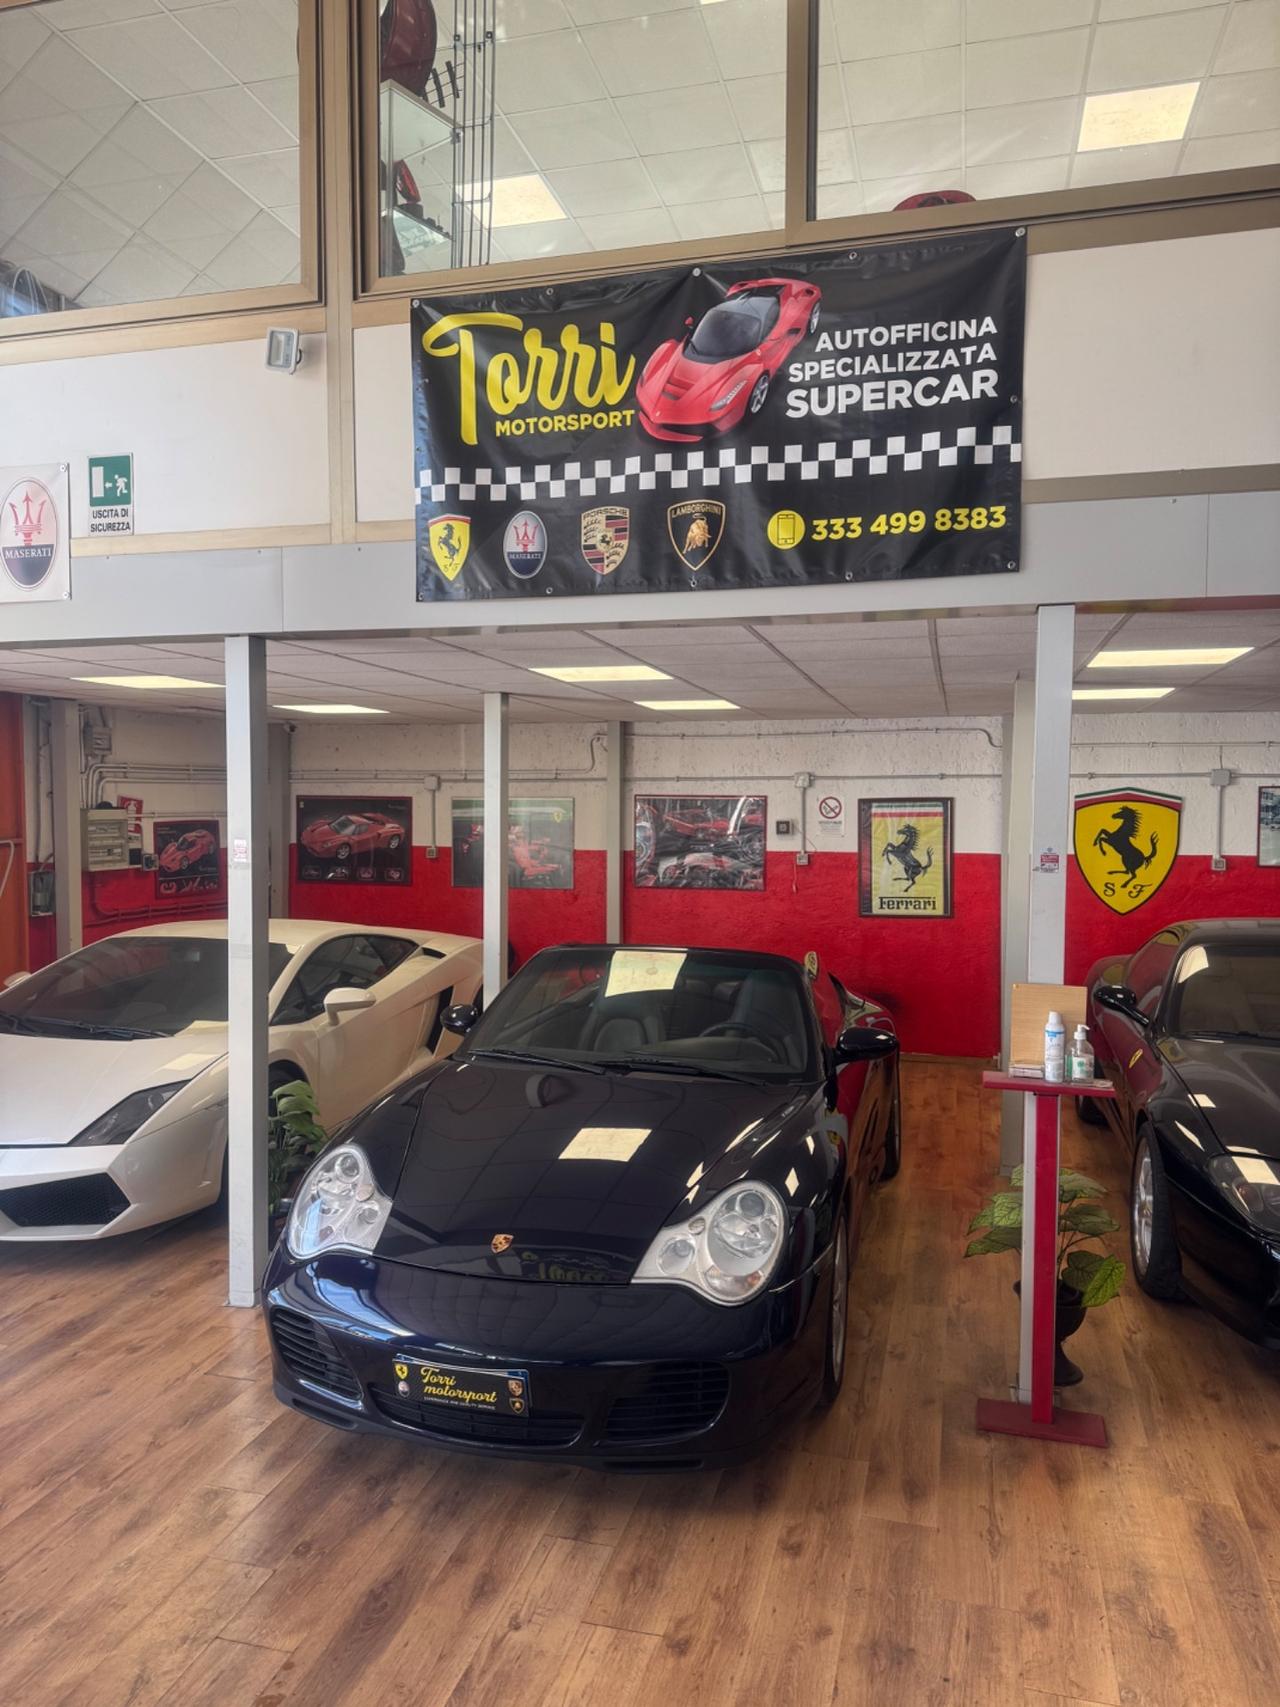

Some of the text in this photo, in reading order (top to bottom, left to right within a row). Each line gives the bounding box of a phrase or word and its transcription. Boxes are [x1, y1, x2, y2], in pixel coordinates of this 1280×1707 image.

[815, 316, 998, 352] AUTOFFICINA
[788, 343, 997, 383] SPECIALIZZATA
[422, 312, 636, 445] Torri
[785, 369, 999, 419] SUPERCAR
[495, 409, 636, 437] MOTORSPORT
[92, 508, 129, 519] USCITA DI
[672, 503, 721, 518] LAMBORGHINI
[90, 521, 131, 533] SICUREZZA
[811, 505, 1007, 541] 333 499 8383
[5, 547, 52, 559] MASERATI
[878, 896, 937, 910] Ferrari
[421, 1367, 456, 1385] Torri
[424, 1386, 496, 1402] motorsport
